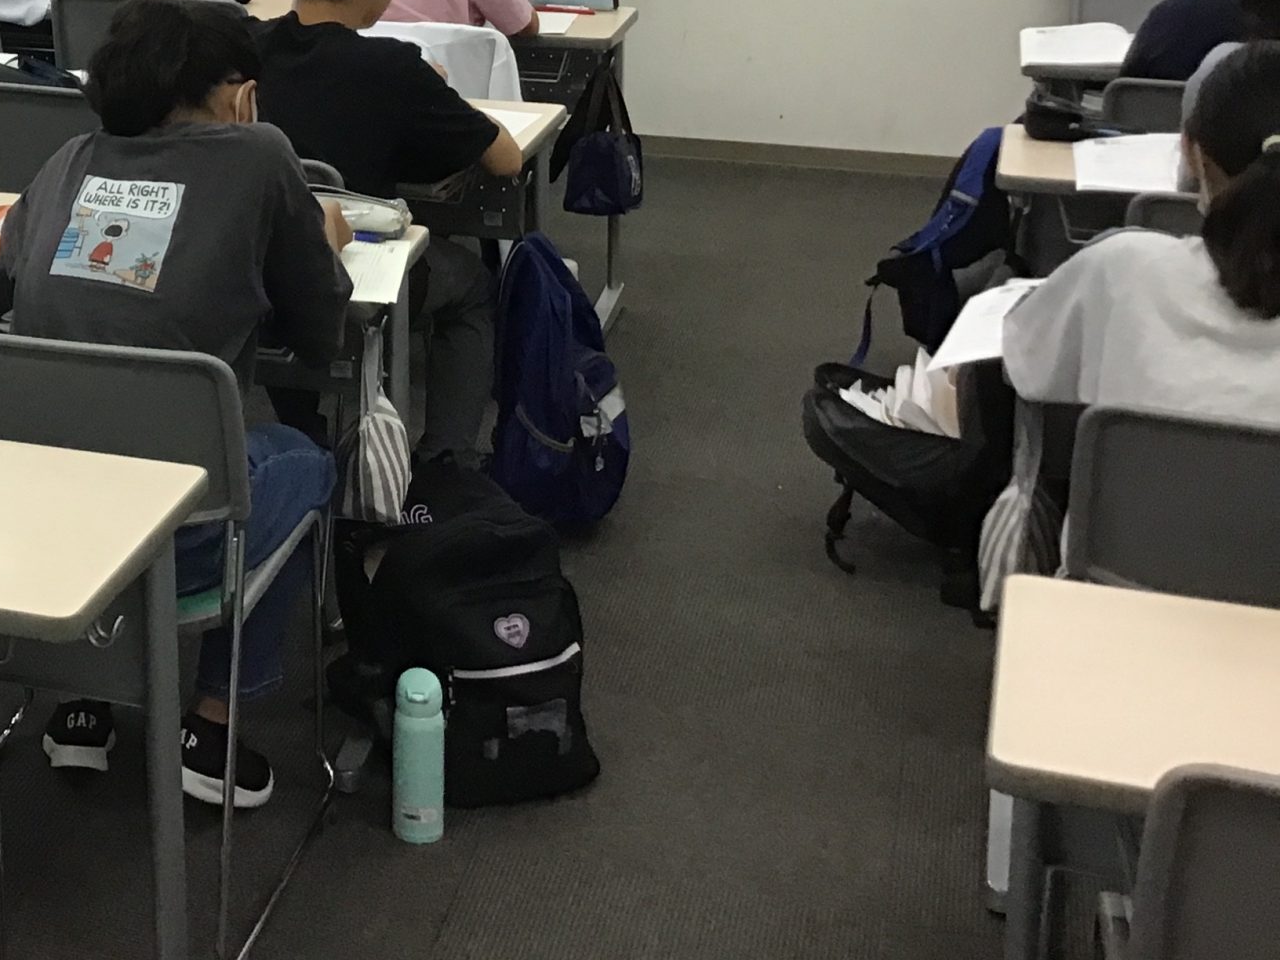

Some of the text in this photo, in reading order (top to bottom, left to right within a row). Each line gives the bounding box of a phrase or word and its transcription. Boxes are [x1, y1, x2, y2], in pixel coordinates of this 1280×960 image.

[96, 181, 123, 195] ALL
[83, 192, 124, 207] WHERE
[126, 197, 140, 209] IS
[66, 711, 97, 730] GAP
